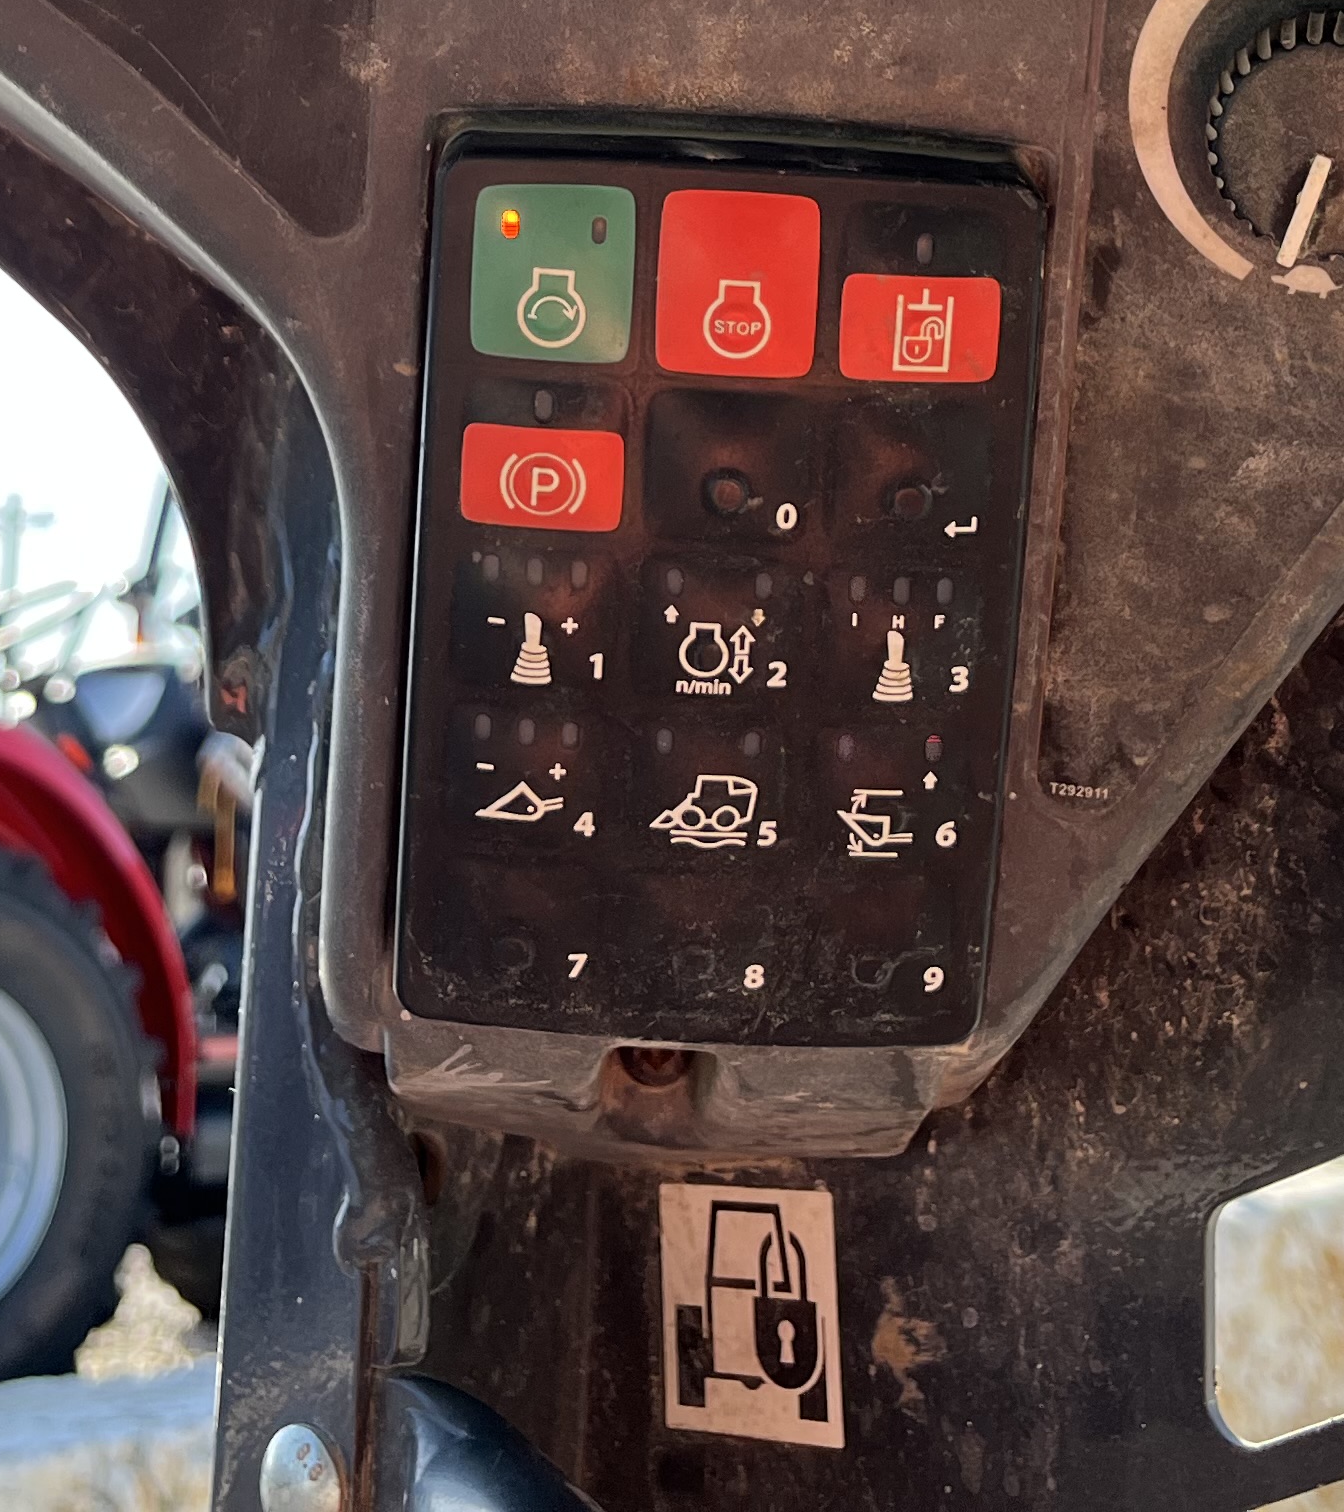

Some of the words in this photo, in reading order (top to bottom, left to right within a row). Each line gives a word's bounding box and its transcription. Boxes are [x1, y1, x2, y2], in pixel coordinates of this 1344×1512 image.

[714, 319, 762, 336] STOP
[531, 467, 560, 506] P
[892, 614, 905, 629] H
[934, 614, 946, 629] F
[589, 653, 603, 680] 1
[766, 661, 787, 687] 2
[948, 665, 969, 693] 3
[675, 678, 732, 695] n/min
[573, 811, 596, 837] 4
[756, 820, 777, 847] 5
[935, 820, 957, 847] 6
[567, 953, 588, 978] 7
[743, 964, 765, 989] 8
[923, 966, 944, 992] 9
